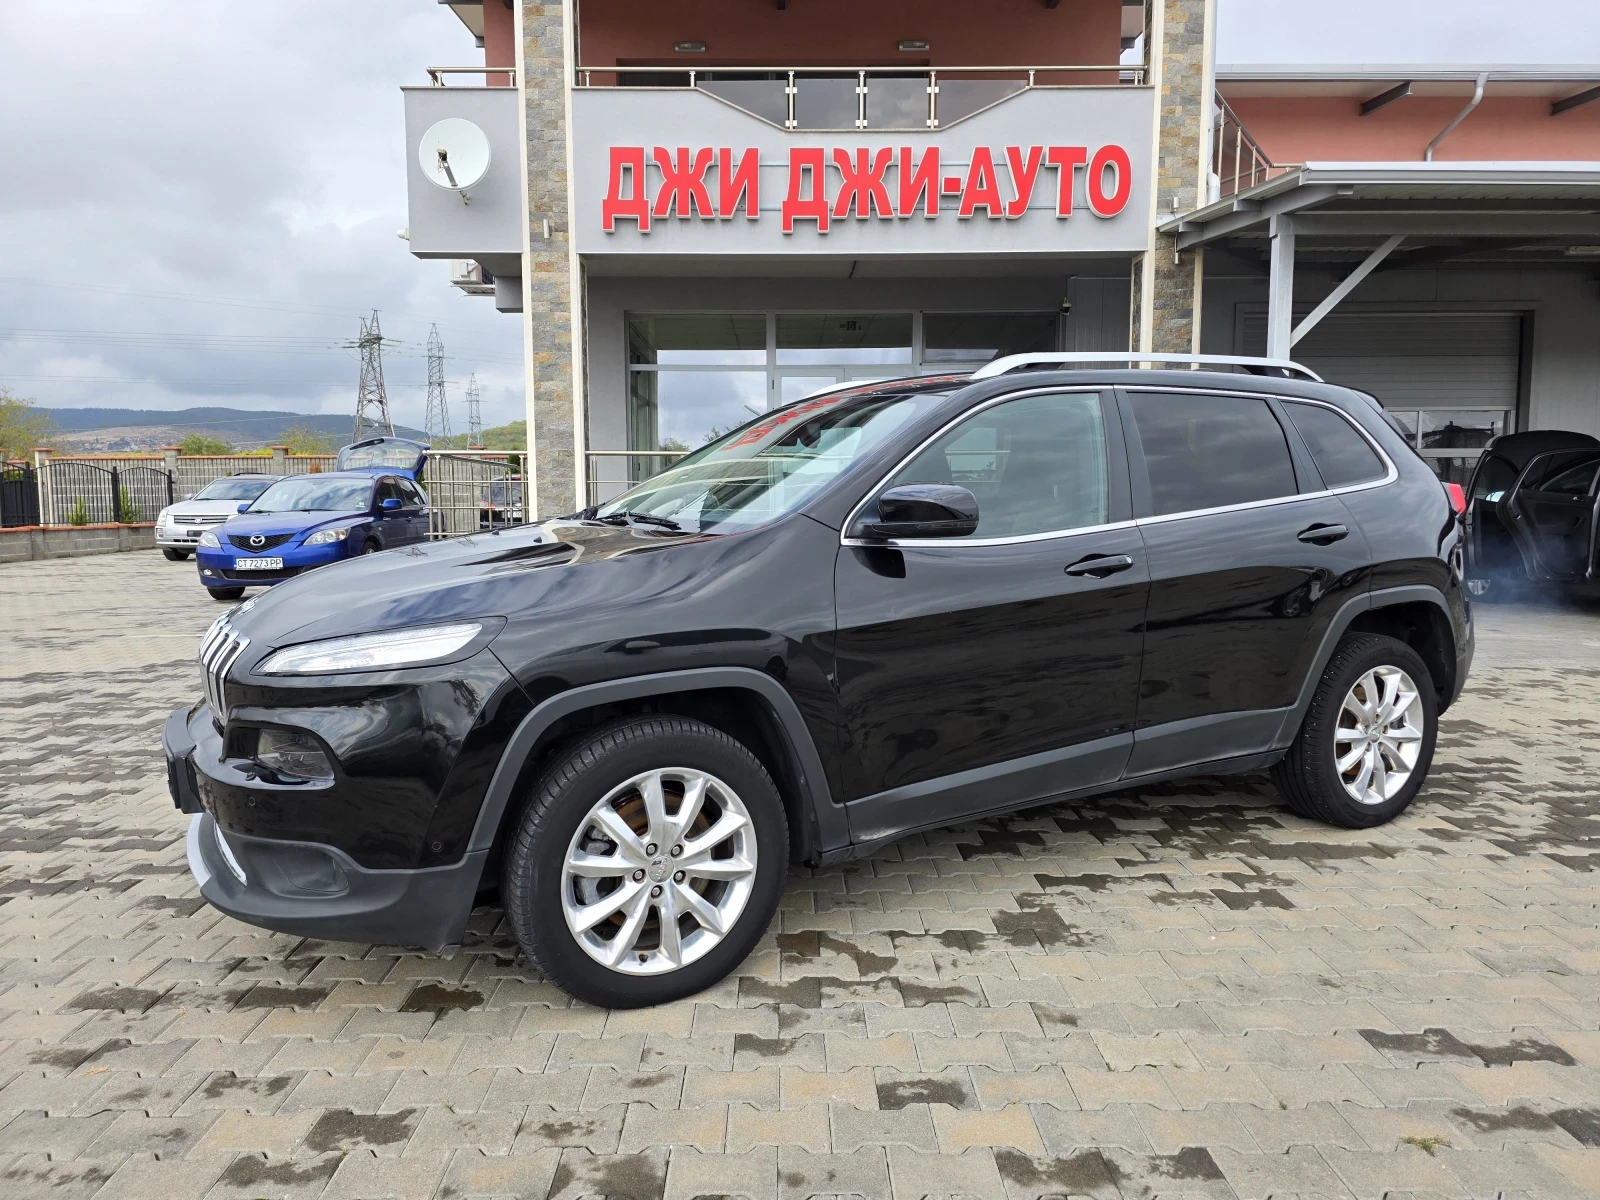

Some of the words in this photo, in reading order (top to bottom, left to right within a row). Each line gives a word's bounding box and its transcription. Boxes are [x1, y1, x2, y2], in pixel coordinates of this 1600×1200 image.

[602, 146, 759, 233] ДЖИ
[781, 144, 1133, 233] ДЖИ-АУТО
[249, 559, 269, 568] 7273
